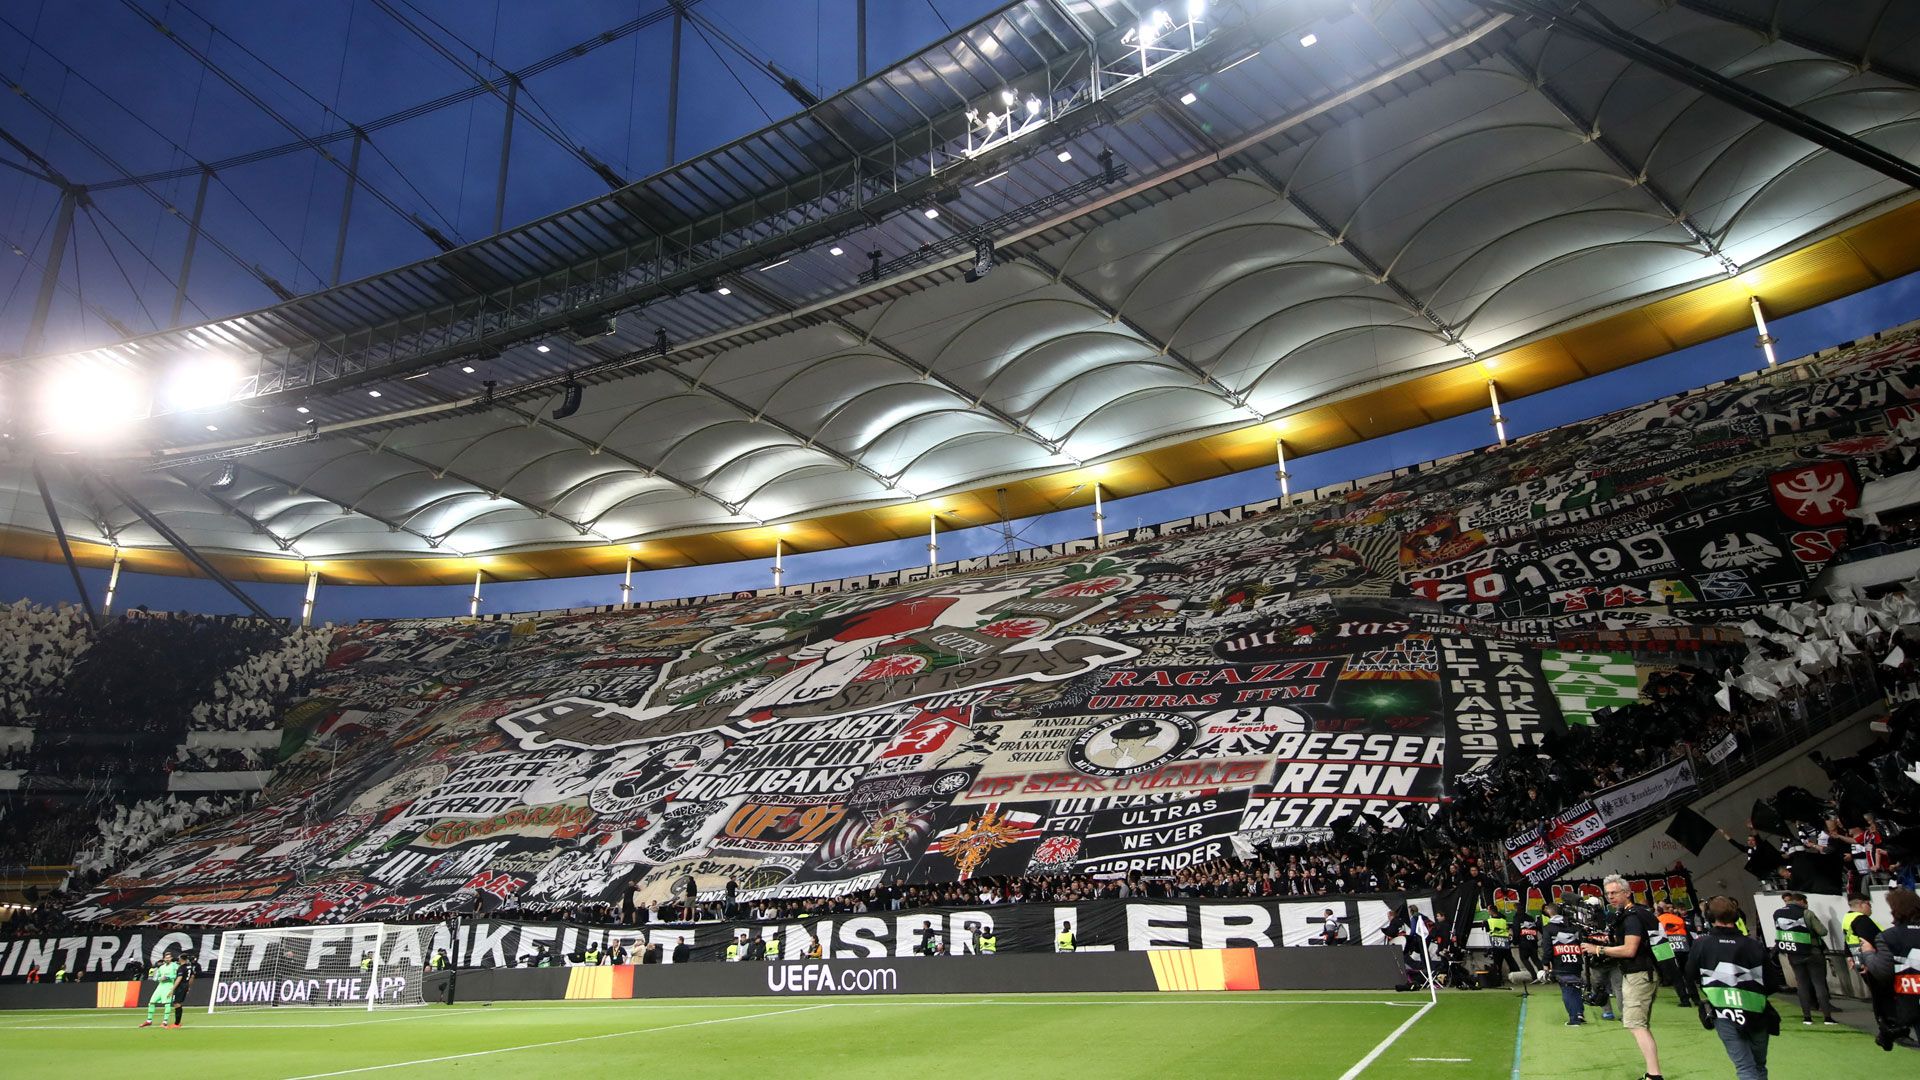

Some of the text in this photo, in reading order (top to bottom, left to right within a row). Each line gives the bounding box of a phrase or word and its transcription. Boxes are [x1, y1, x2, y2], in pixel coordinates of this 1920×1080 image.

[1515, 538, 1664, 588] 1899
[932, 632, 996, 655] GUTEN
[943, 648, 1030, 688] 1997
[1102, 660, 1334, 688] RAGAZZI
[926, 690, 991, 711] UF97
[1087, 683, 1321, 711] ULTRAS FFM
[1032, 715, 1099, 728] RANDALE
[1076, 728, 1101, 747] MER
[1171, 715, 1193, 732] NET
[1207, 723, 1279, 734] Eintracht
[704, 737, 891, 775] FRANKFURT
[1007, 750, 1065, 764] SCHULE
[1271, 732, 1446, 765] BESSER
[868, 755, 924, 772] ACAB
[1074, 759, 1094, 775] MIT
[679, 766, 866, 801] HOOLIGANS
[1272, 762, 1421, 796] RENN
[723, 804, 796, 839] UF
[787, 804, 849, 842] 97
[1121, 799, 1218, 825] ULTRAS
[1123, 823, 1204, 850] NEVER
[1652, 839, 1678, 851] Arena
[696, 886, 777, 903] EINTACHT
[778, 874, 881, 900] FRANKFURT
[1778, 941, 1797, 951] 055
[1781, 932, 1794, 941] HB
[1561, 954, 1578, 963] 013
[325, 978, 362, 1002] THE
[767, 963, 898, 992] UEFA.com
[1723, 989, 1743, 1007] HI
